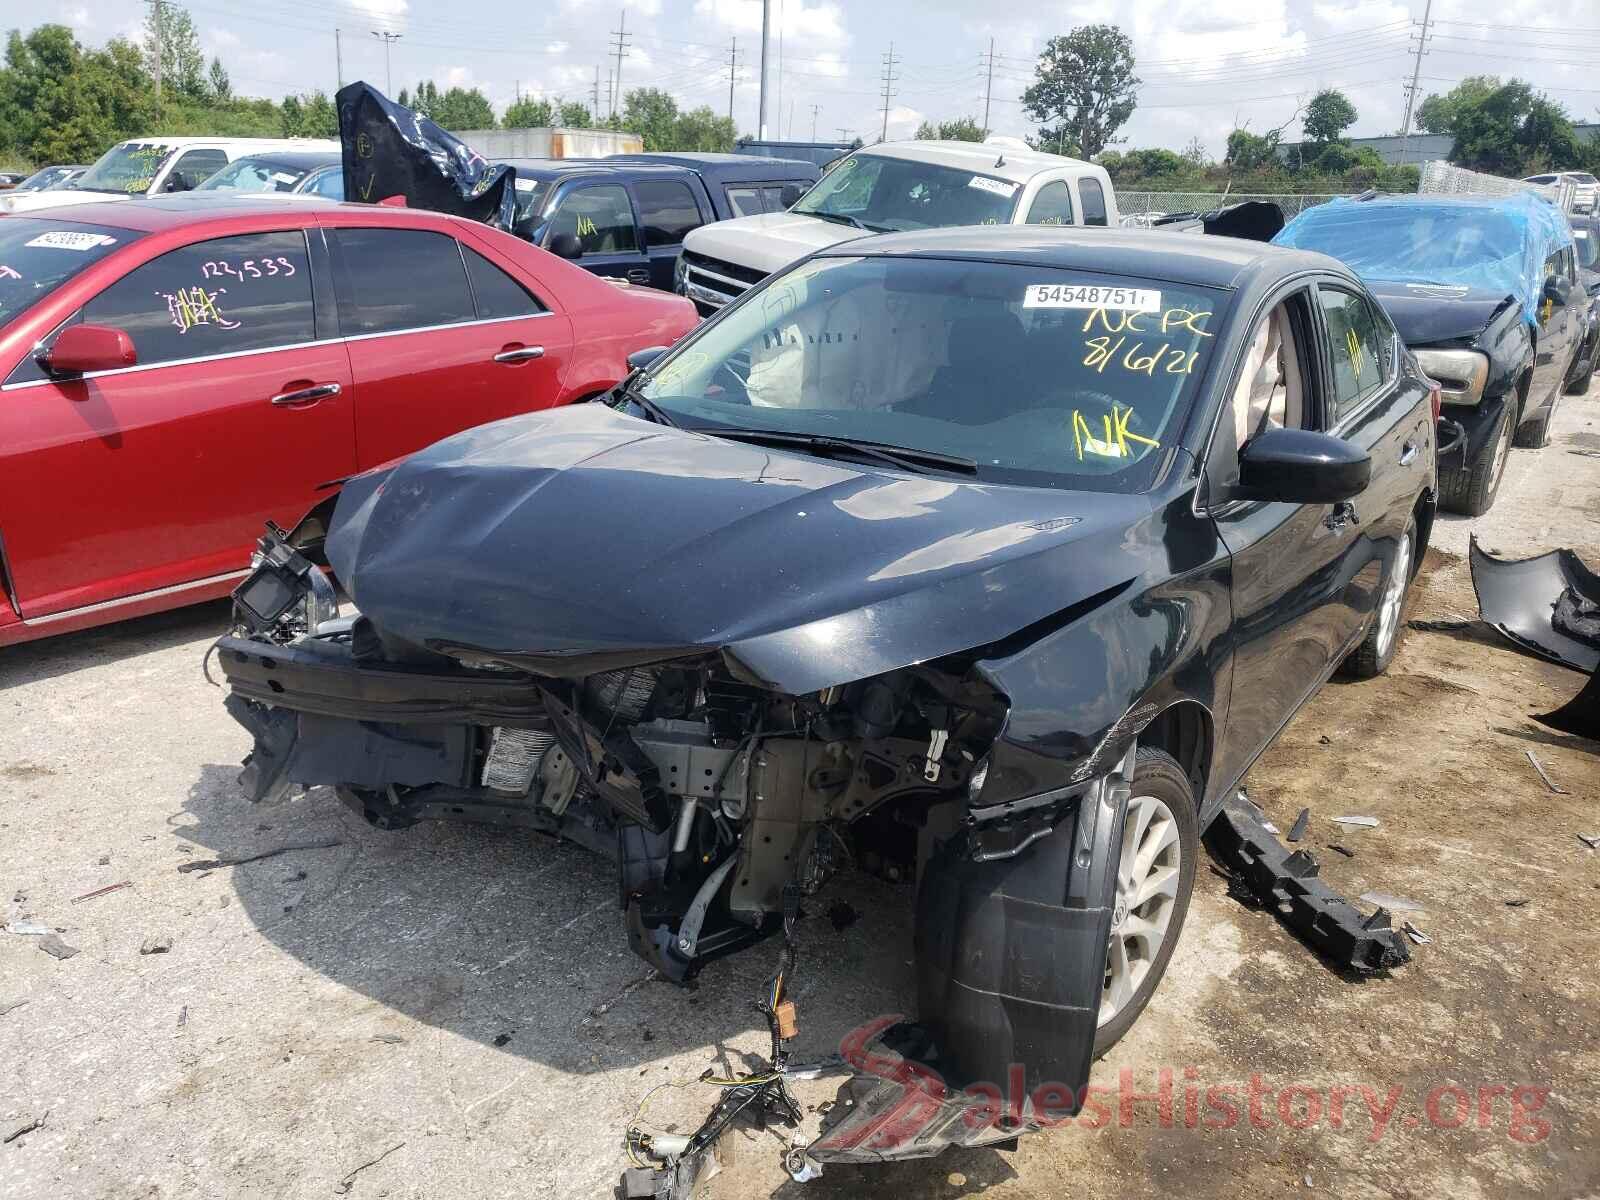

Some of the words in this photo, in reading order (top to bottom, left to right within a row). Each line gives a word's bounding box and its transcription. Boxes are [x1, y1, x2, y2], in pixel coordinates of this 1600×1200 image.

[576, 214, 598, 237] NA
[1037, 286, 1138, 305] 54548751
[1082, 336, 1200, 376] 8/6/21
[1072, 405, 1160, 461] NK
